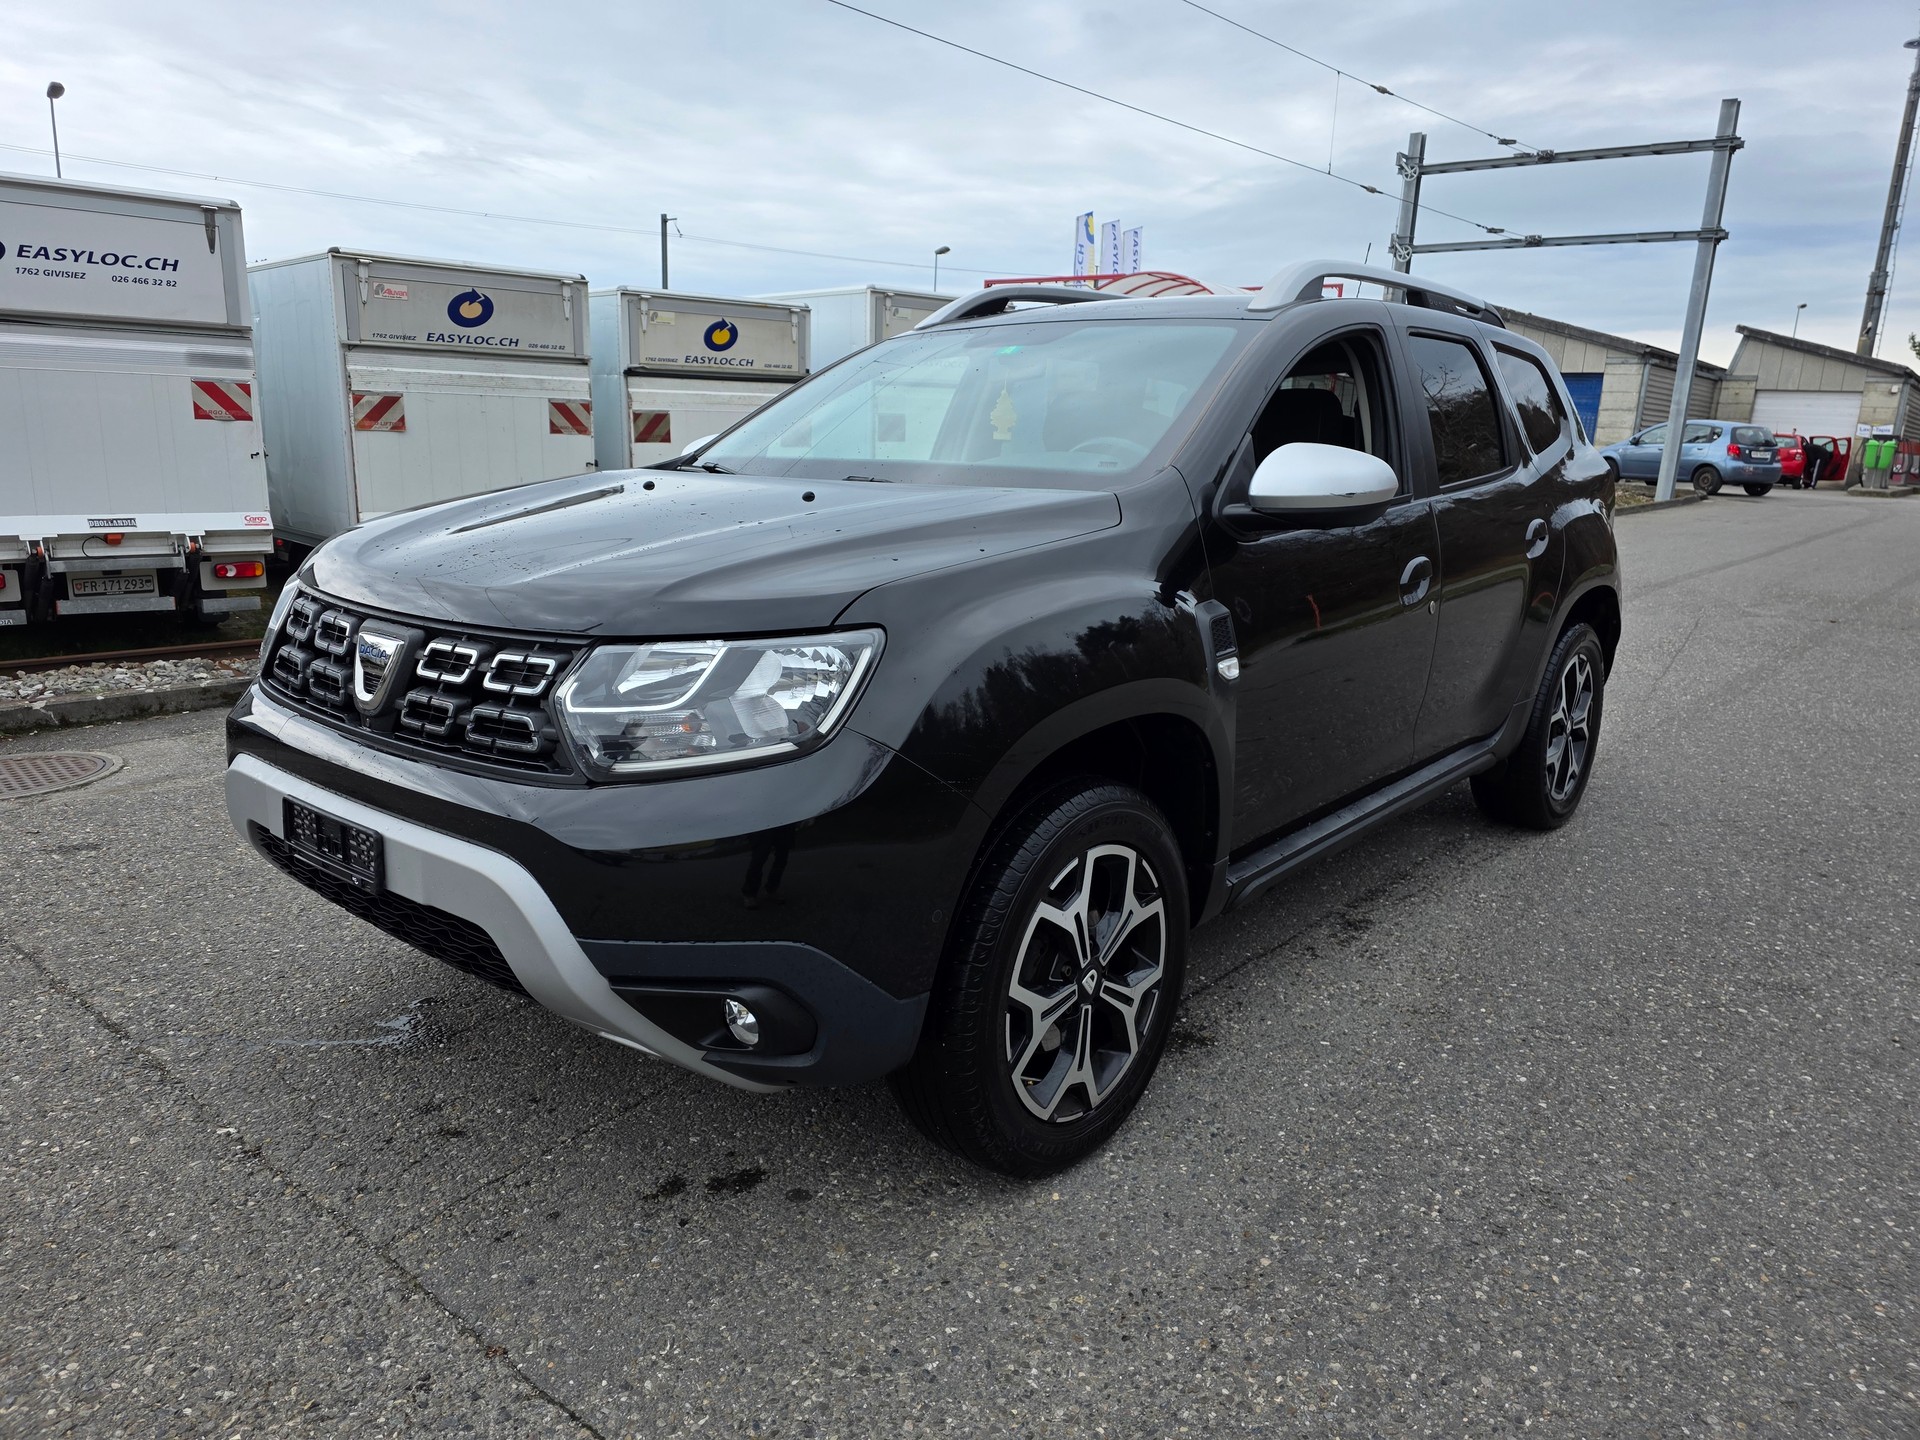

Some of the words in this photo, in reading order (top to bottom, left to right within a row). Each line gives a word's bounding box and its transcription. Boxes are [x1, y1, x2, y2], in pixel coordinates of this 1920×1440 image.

[16, 244, 180, 272] EASYLOC.CH
[15, 267, 40, 276] 1762
[43, 269, 87, 280] GIVISIEZ
[111, 275, 130, 284] 026
[131, 277, 150, 285] 466
[152, 278, 163, 287] 32
[165, 279, 178, 288] 82
[388, 333, 417, 341] GIVISIEZ
[426, 332, 519, 348] EASYLOC.CH
[684, 355, 754, 367] EASYLOC.CH
[88, 518, 137, 528] DHOLLANDIA
[244, 515, 267, 524] Cargo
[360, 644, 387, 658] DACIA
